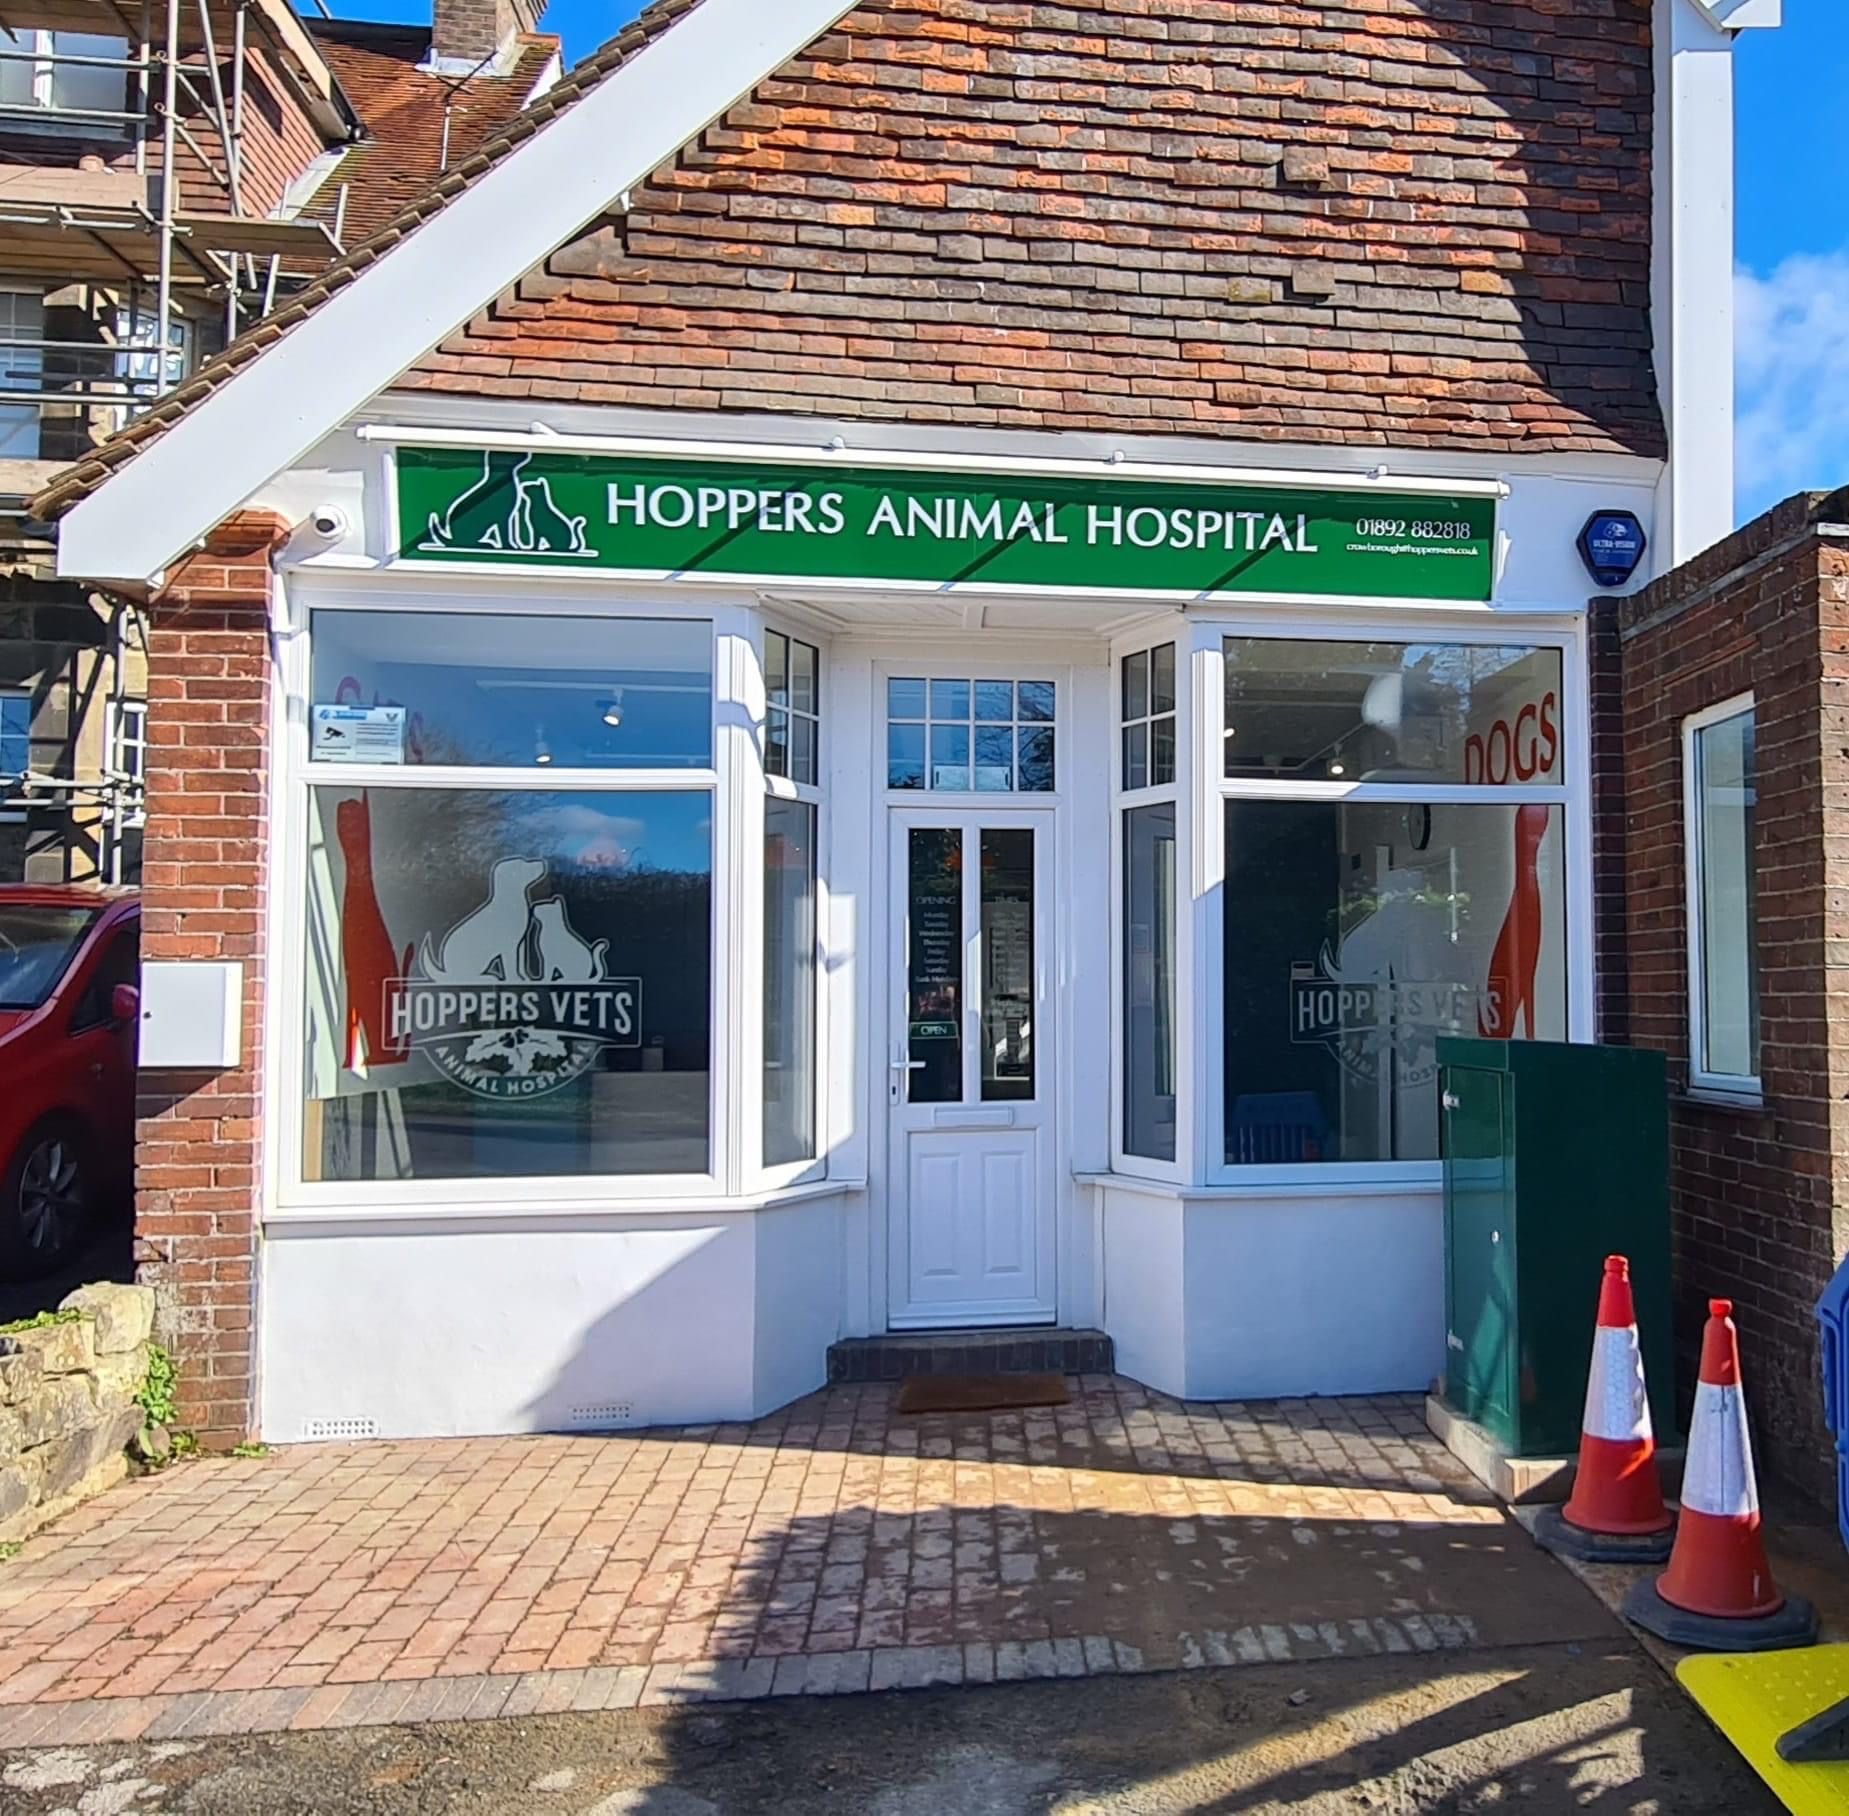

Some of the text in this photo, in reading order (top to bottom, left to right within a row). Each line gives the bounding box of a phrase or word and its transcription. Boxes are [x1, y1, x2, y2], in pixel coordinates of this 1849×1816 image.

[606, 482, 1318, 553] HOPPERS ANIMAL HOSPITAL
[1355, 518, 1471, 540] 01892 882818
[1464, 691, 1558, 785] DOGS
[391, 991, 633, 1039] HOPPERS VETS
[920, 1025, 948, 1036] OPEN
[434, 1042, 593, 1096] ANIMAL HOSPITAL
